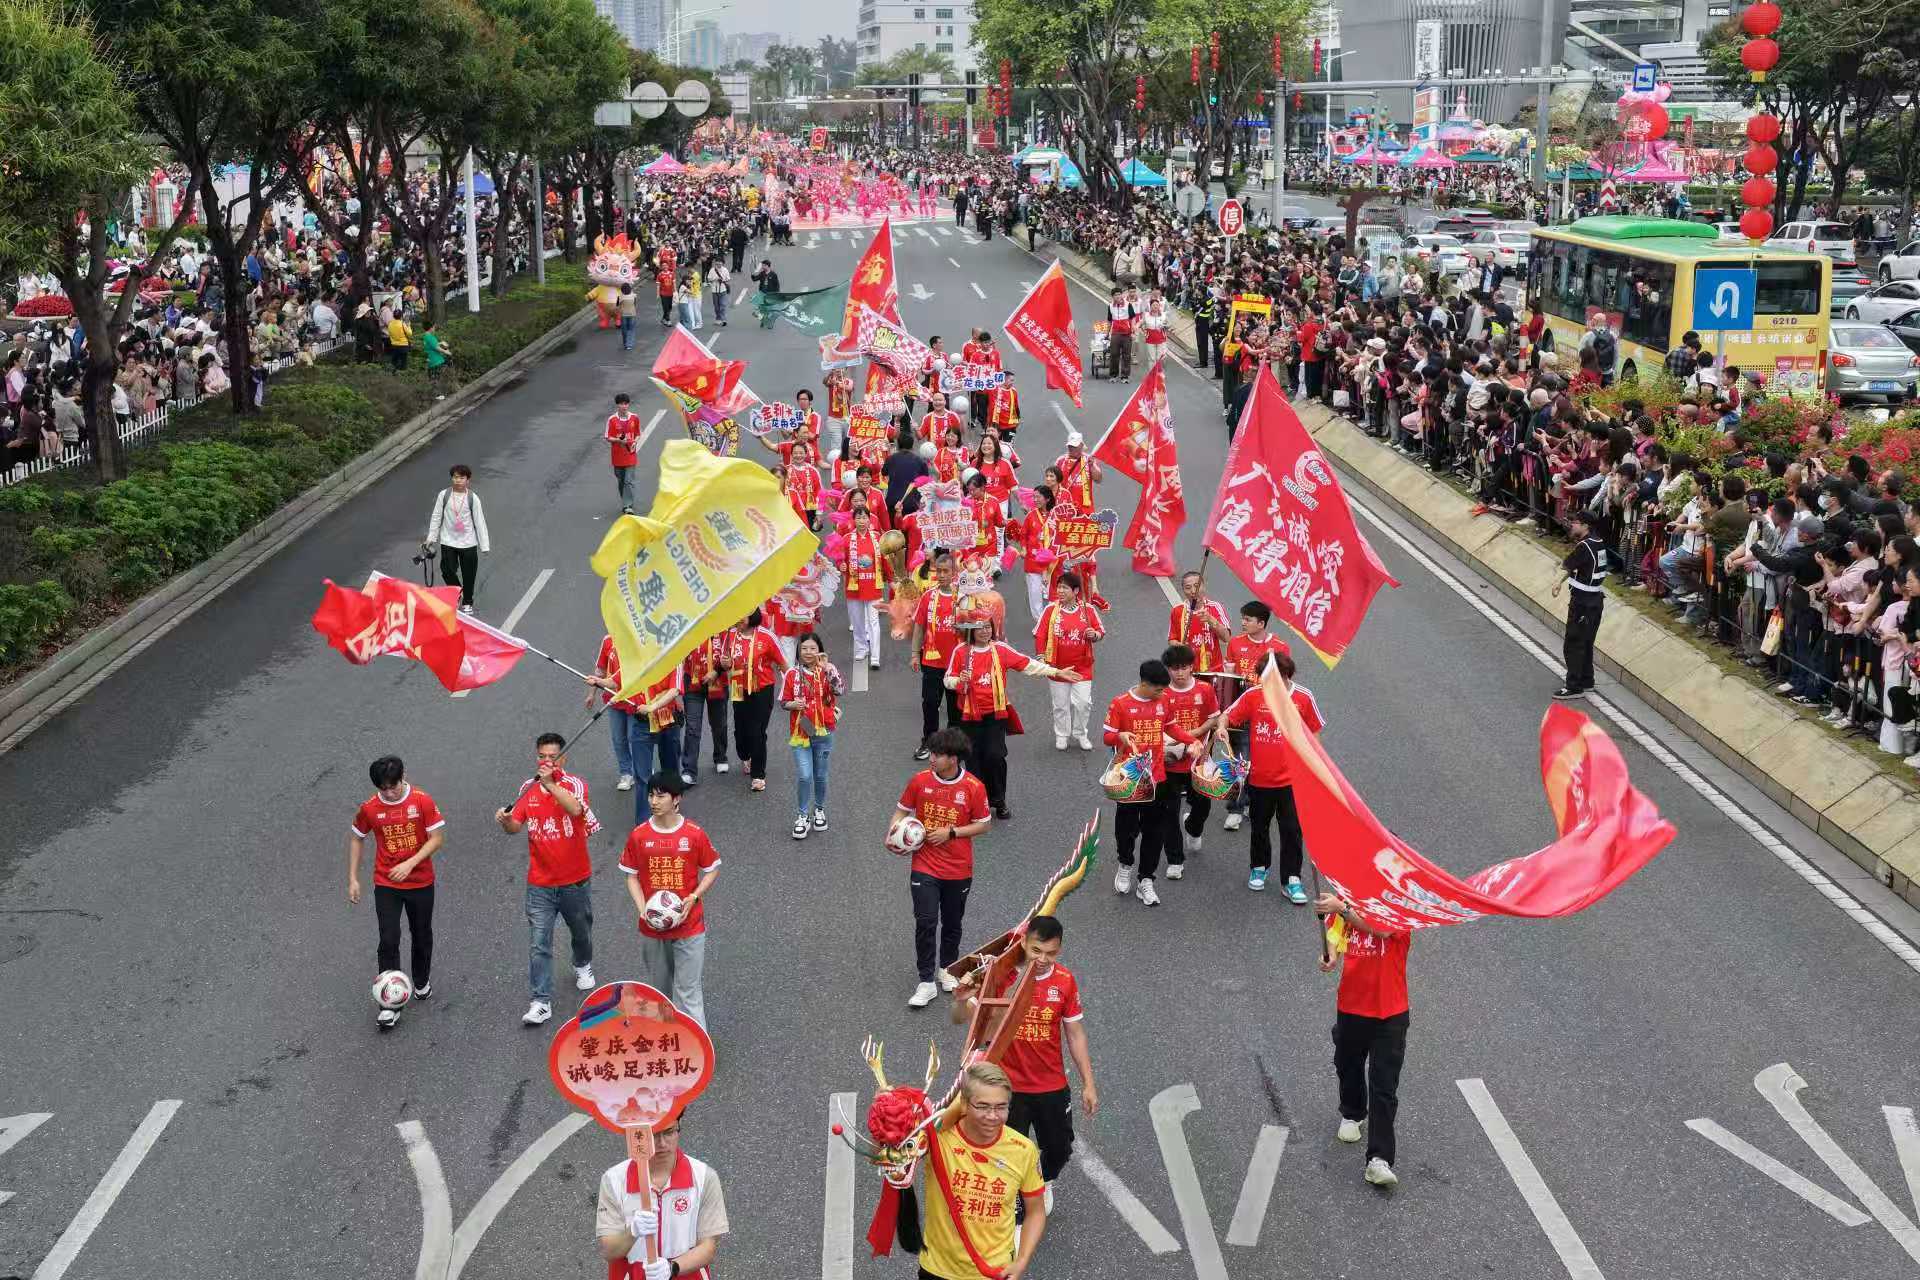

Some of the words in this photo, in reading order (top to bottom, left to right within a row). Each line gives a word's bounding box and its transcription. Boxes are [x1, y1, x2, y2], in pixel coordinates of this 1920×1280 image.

[1223, 206, 1240, 232] 停
[1772, 317, 1798, 326] 621D
[917, 508, 971, 526] 金利龙舟
[1058, 521, 1099, 534] 好五金
[1215, 495, 1332, 637] 值得相信
[1132, 719, 1162, 730] 好五金
[923, 801, 960, 820] 好五金
[382, 821, 416, 837] 好五金
[648, 855, 686, 869] 好五金
[650, 872, 685, 886] 金利造
[578, 1032, 681, 1060] 肇庆金利
[566, 1056, 698, 1083] 诚峻足球队
[952, 1169, 1007, 1195] 好五金
[952, 1194, 1002, 1217] 金利造
